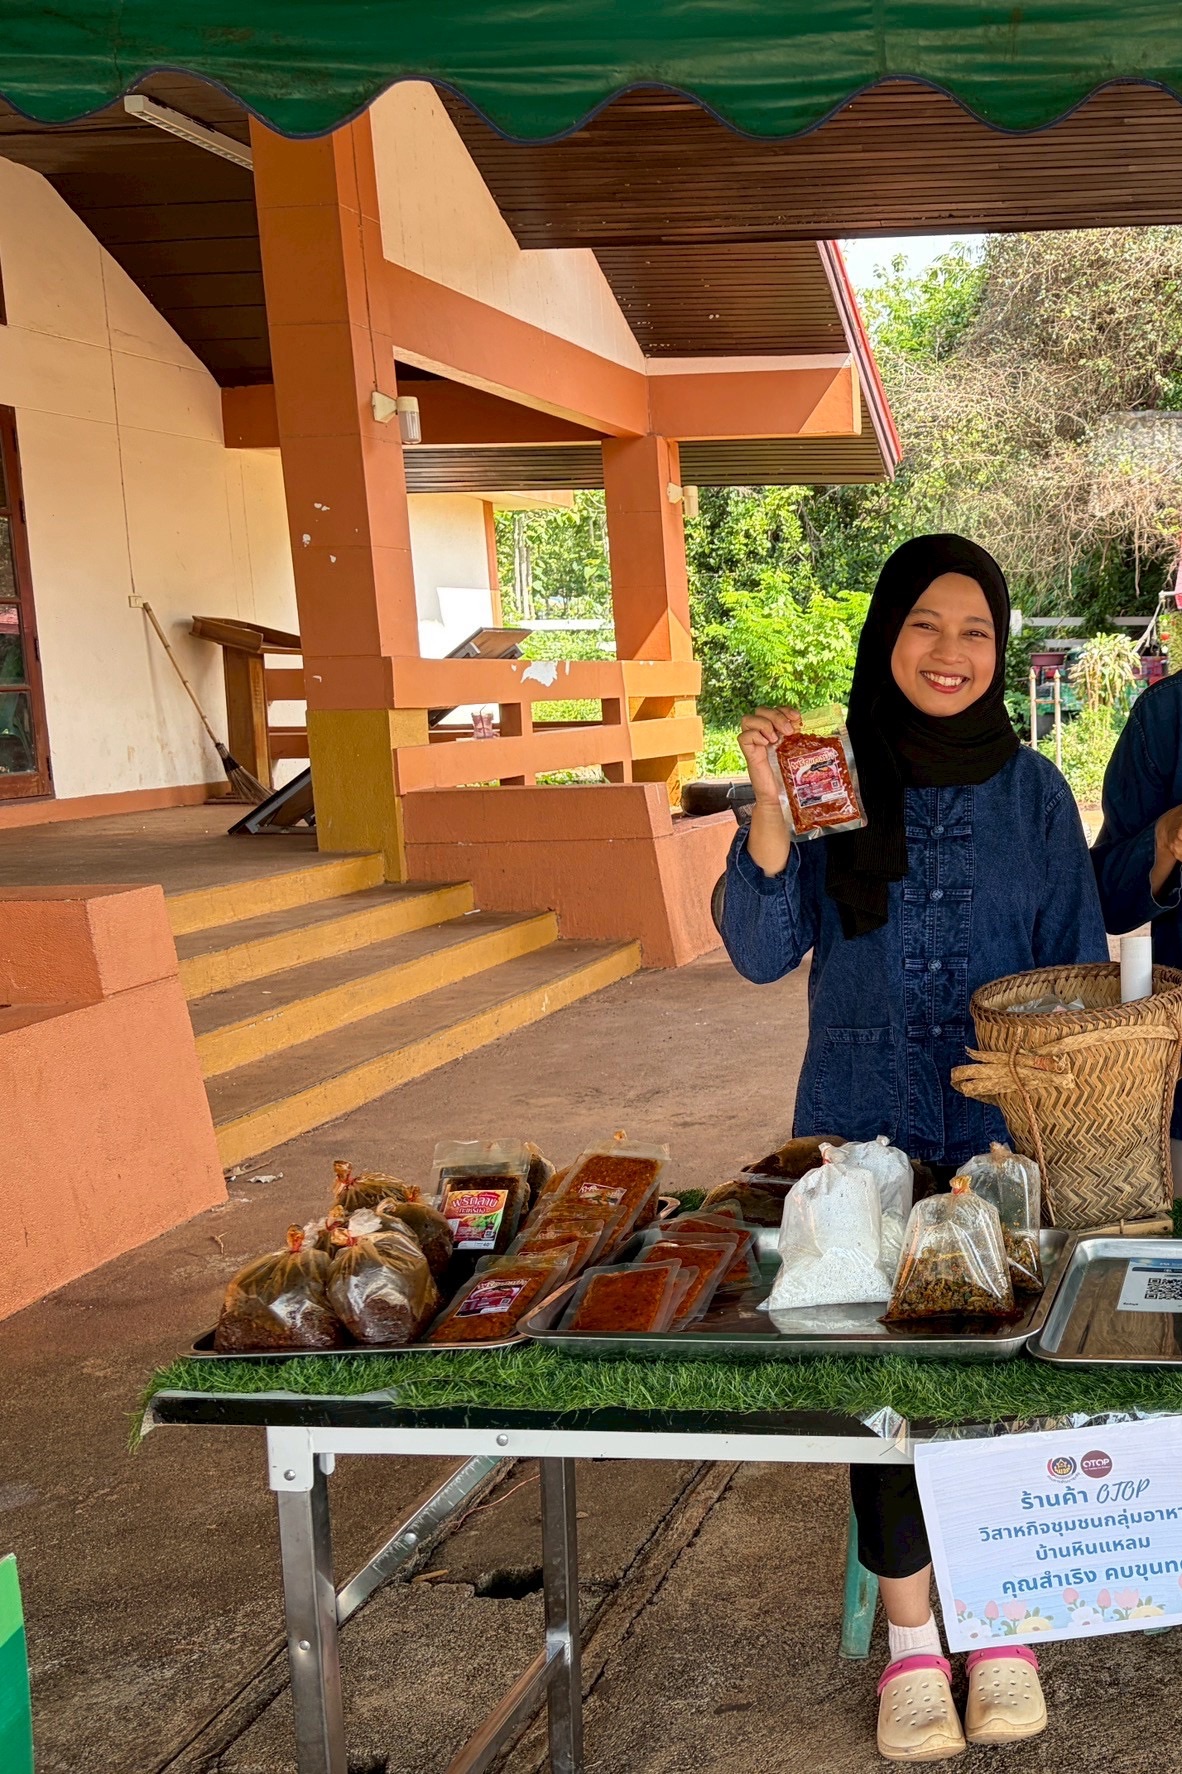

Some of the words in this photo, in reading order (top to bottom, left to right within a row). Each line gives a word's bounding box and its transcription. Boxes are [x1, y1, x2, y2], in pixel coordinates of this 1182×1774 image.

[1082, 1458, 1110, 1468] OTOP
[1021, 1485, 1088, 1510] ร้านค้า
[1096, 1478, 1150, 1504] OTOP
[1036, 1536, 1151, 1561] บ้านหินแหลม
[1002, 1567, 1098, 1599] คุณสำเริง
